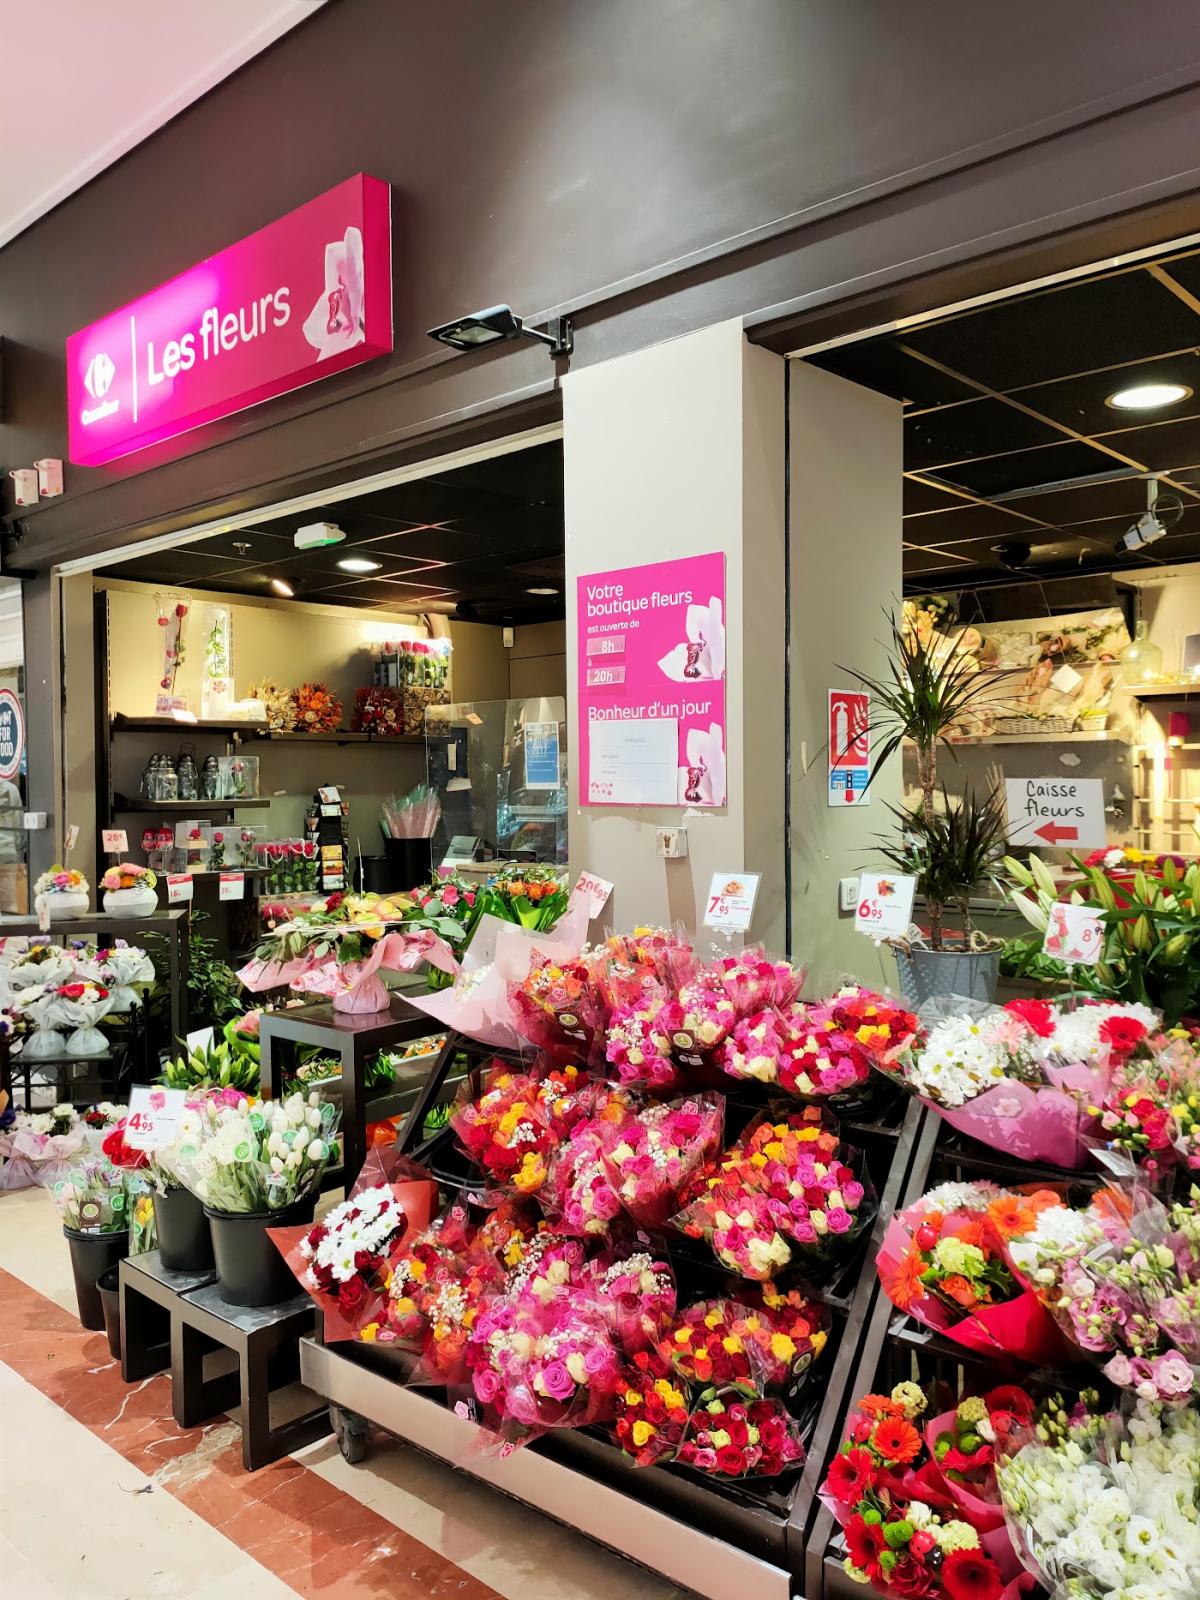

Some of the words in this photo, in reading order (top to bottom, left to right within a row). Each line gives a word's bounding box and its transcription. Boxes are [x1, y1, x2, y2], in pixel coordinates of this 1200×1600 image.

[147, 333, 195, 385] Les
[199, 287, 290, 360] fleurs
[587, 584, 623, 600] Votre
[587, 597, 648, 617] boutique
[650, 591, 692, 608] fleurs
[587, 625, 599, 633] est
[600, 621, 628, 632] ouverte
[629, 619, 640, 628] de
[601, 640, 614, 652] 8h
[594, 670, 613, 682] 20h
[588, 704, 646, 720] Bonheur
[648, 701, 679, 718] d'un
[681, 699, 711, 719] jour
[1026, 780, 1077, 797] Caisse
[1024, 798, 1085, 817] fleurs
